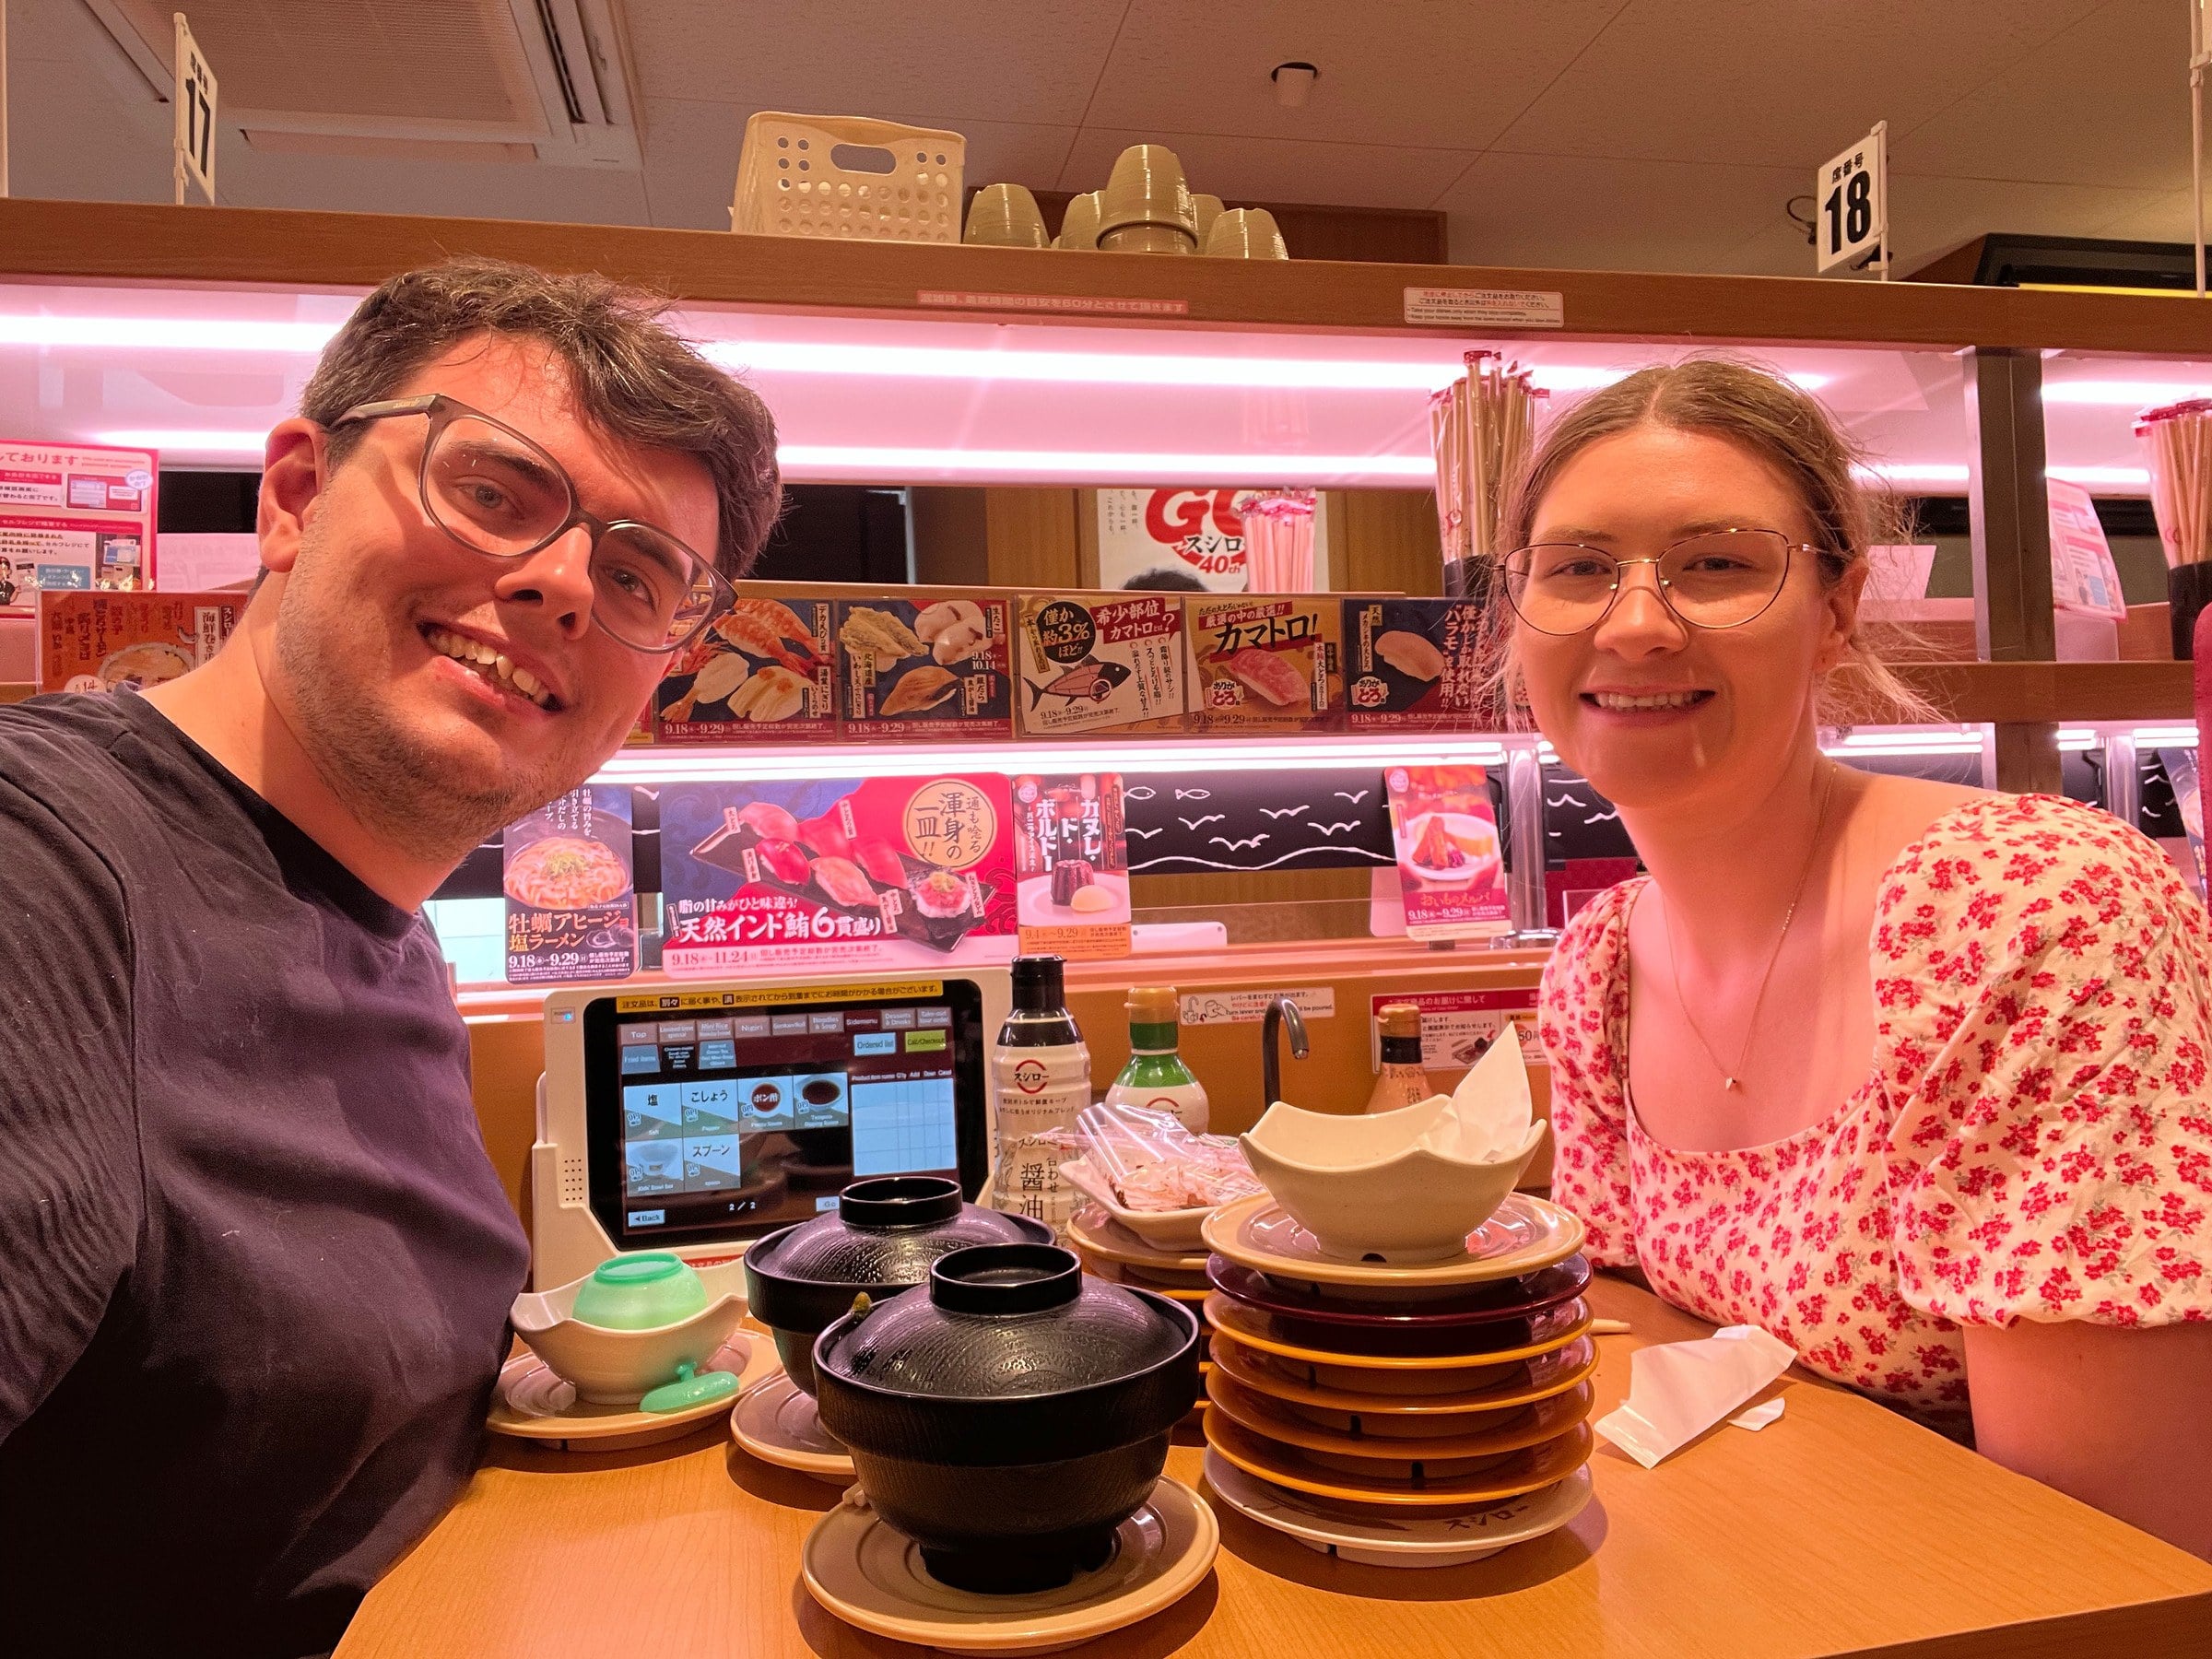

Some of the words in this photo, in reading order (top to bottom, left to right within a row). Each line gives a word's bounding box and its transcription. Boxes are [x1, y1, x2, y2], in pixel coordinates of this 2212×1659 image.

[185, 77, 211, 178] 17
[1831, 151, 1865, 184] 席番号
[1824, 170, 1872, 256] 18
[1185, 535, 1244, 553] スシロ
[1043, 606, 1075, 628] 僅か
[1096, 599, 1161, 626] 希少部位
[1371, 605, 1381, 624] 天然
[1041, 621, 1091, 648] 約3%
[1214, 612, 1319, 656] カマトロ!
[1212, 690, 1237, 707] とろ
[1358, 688, 1382, 704] とろ
[913, 806, 942, 857] 一皿!!
[938, 791, 968, 861] 渾身の
[966, 795, 982, 854] 通も唸る
[1036, 798, 1057, 873] ボルドー
[677, 896, 798, 914] 脂の甘みがひと味違う!
[508, 910, 629, 935] 牡蠣アヒージョ
[678, 906, 881, 943] 天然インド鮪6貫盛り
[508, 933, 585, 953] 塩ラーメン
[630, 1030, 647, 1040] Top
[857, 1040, 883, 1049] Ordered
[1014, 1072, 1050, 1081] スシロー
[647, 1093, 658, 1106] 塩
[691, 1090, 729, 1103] こしょう
[692, 1145, 730, 1158] スプーン
[728, 1203, 735, 1211] 2
[749, 1201, 756, 1209] 2
[641, 1214, 661, 1222] Back
[1444, 1503, 1530, 1532] スシロー
